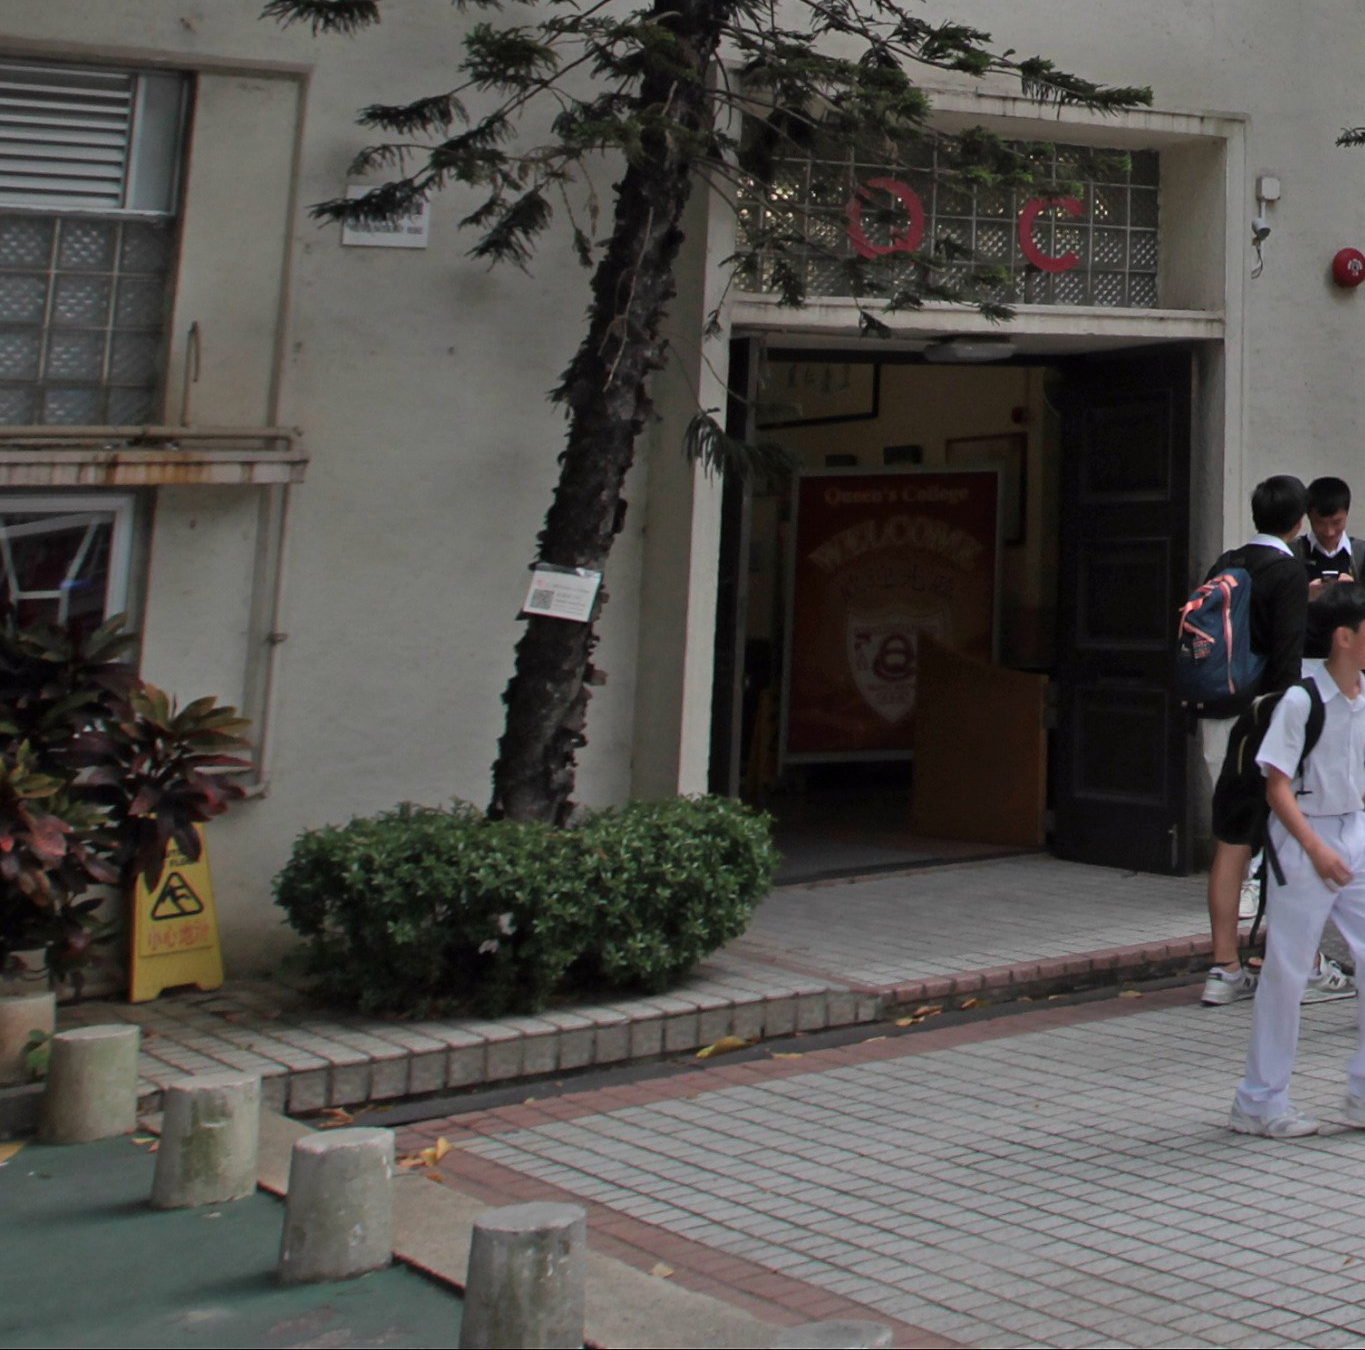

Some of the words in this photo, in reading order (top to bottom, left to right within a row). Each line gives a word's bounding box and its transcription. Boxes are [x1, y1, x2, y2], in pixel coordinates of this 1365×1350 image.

[1019, 198, 1083, 274] C
[824, 486, 898, 506] Queen's
[902, 484, 969, 505] College
[807, 514, 984, 573] WELCOME
